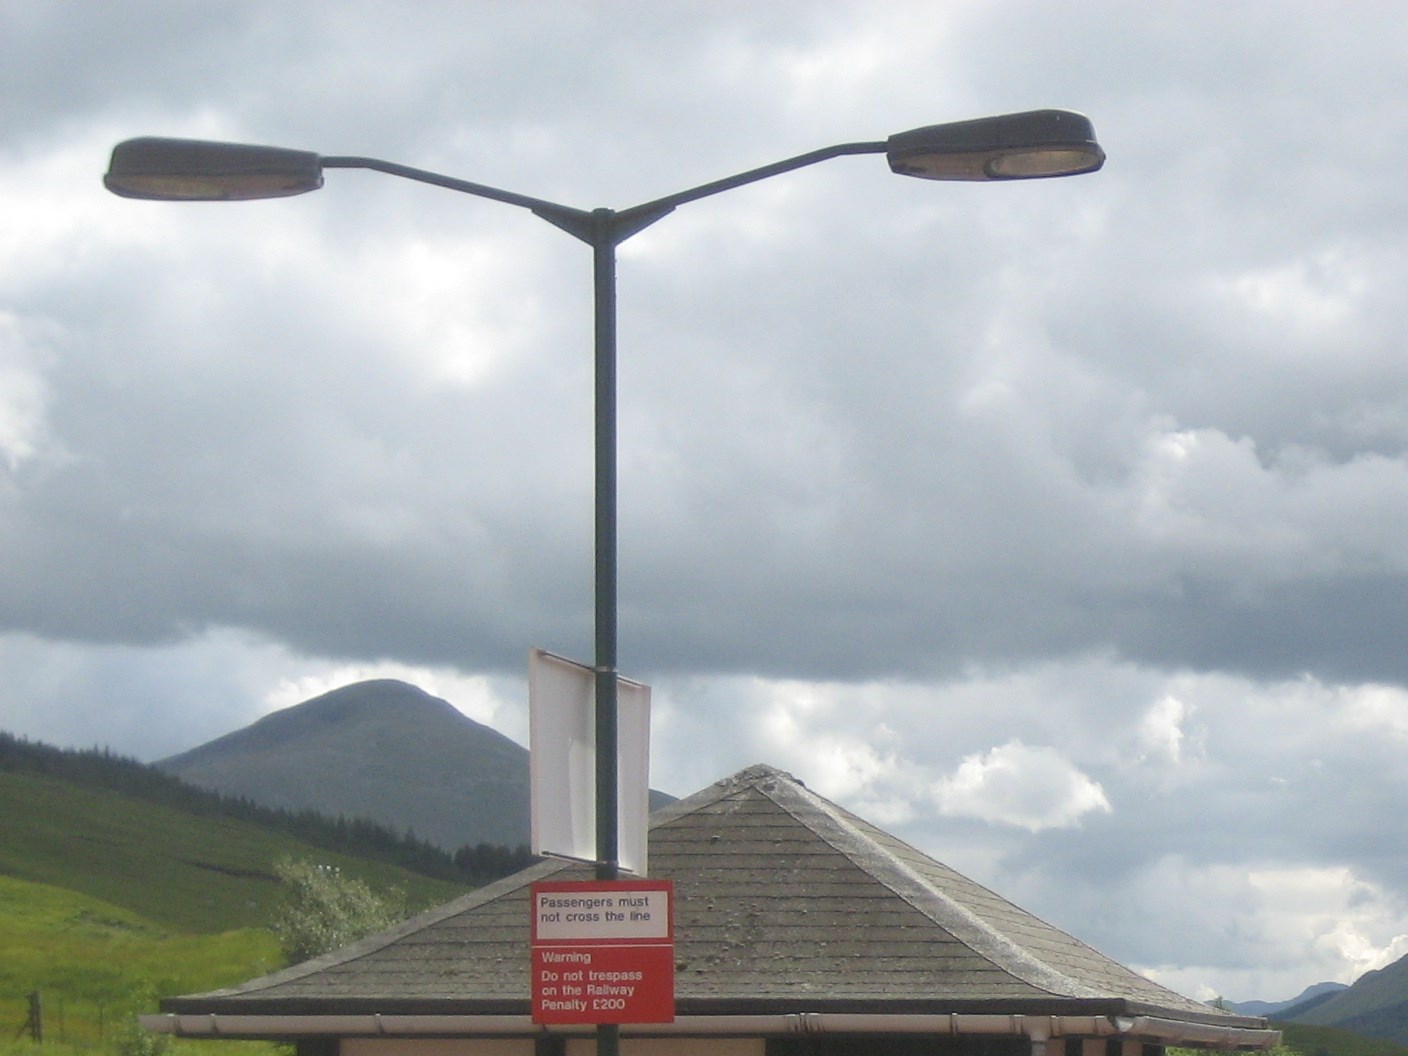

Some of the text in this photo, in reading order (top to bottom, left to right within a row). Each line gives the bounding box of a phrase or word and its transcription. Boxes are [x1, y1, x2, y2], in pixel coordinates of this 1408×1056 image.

[541, 896, 649, 909] Passengers must
[541, 911, 651, 922] not cross the line
[542, 952, 591, 964] Warning
[541, 970, 642, 983] Do not trespass
[542, 984, 635, 997] on the Railway
[541, 999, 626, 1012] Penalty £200
